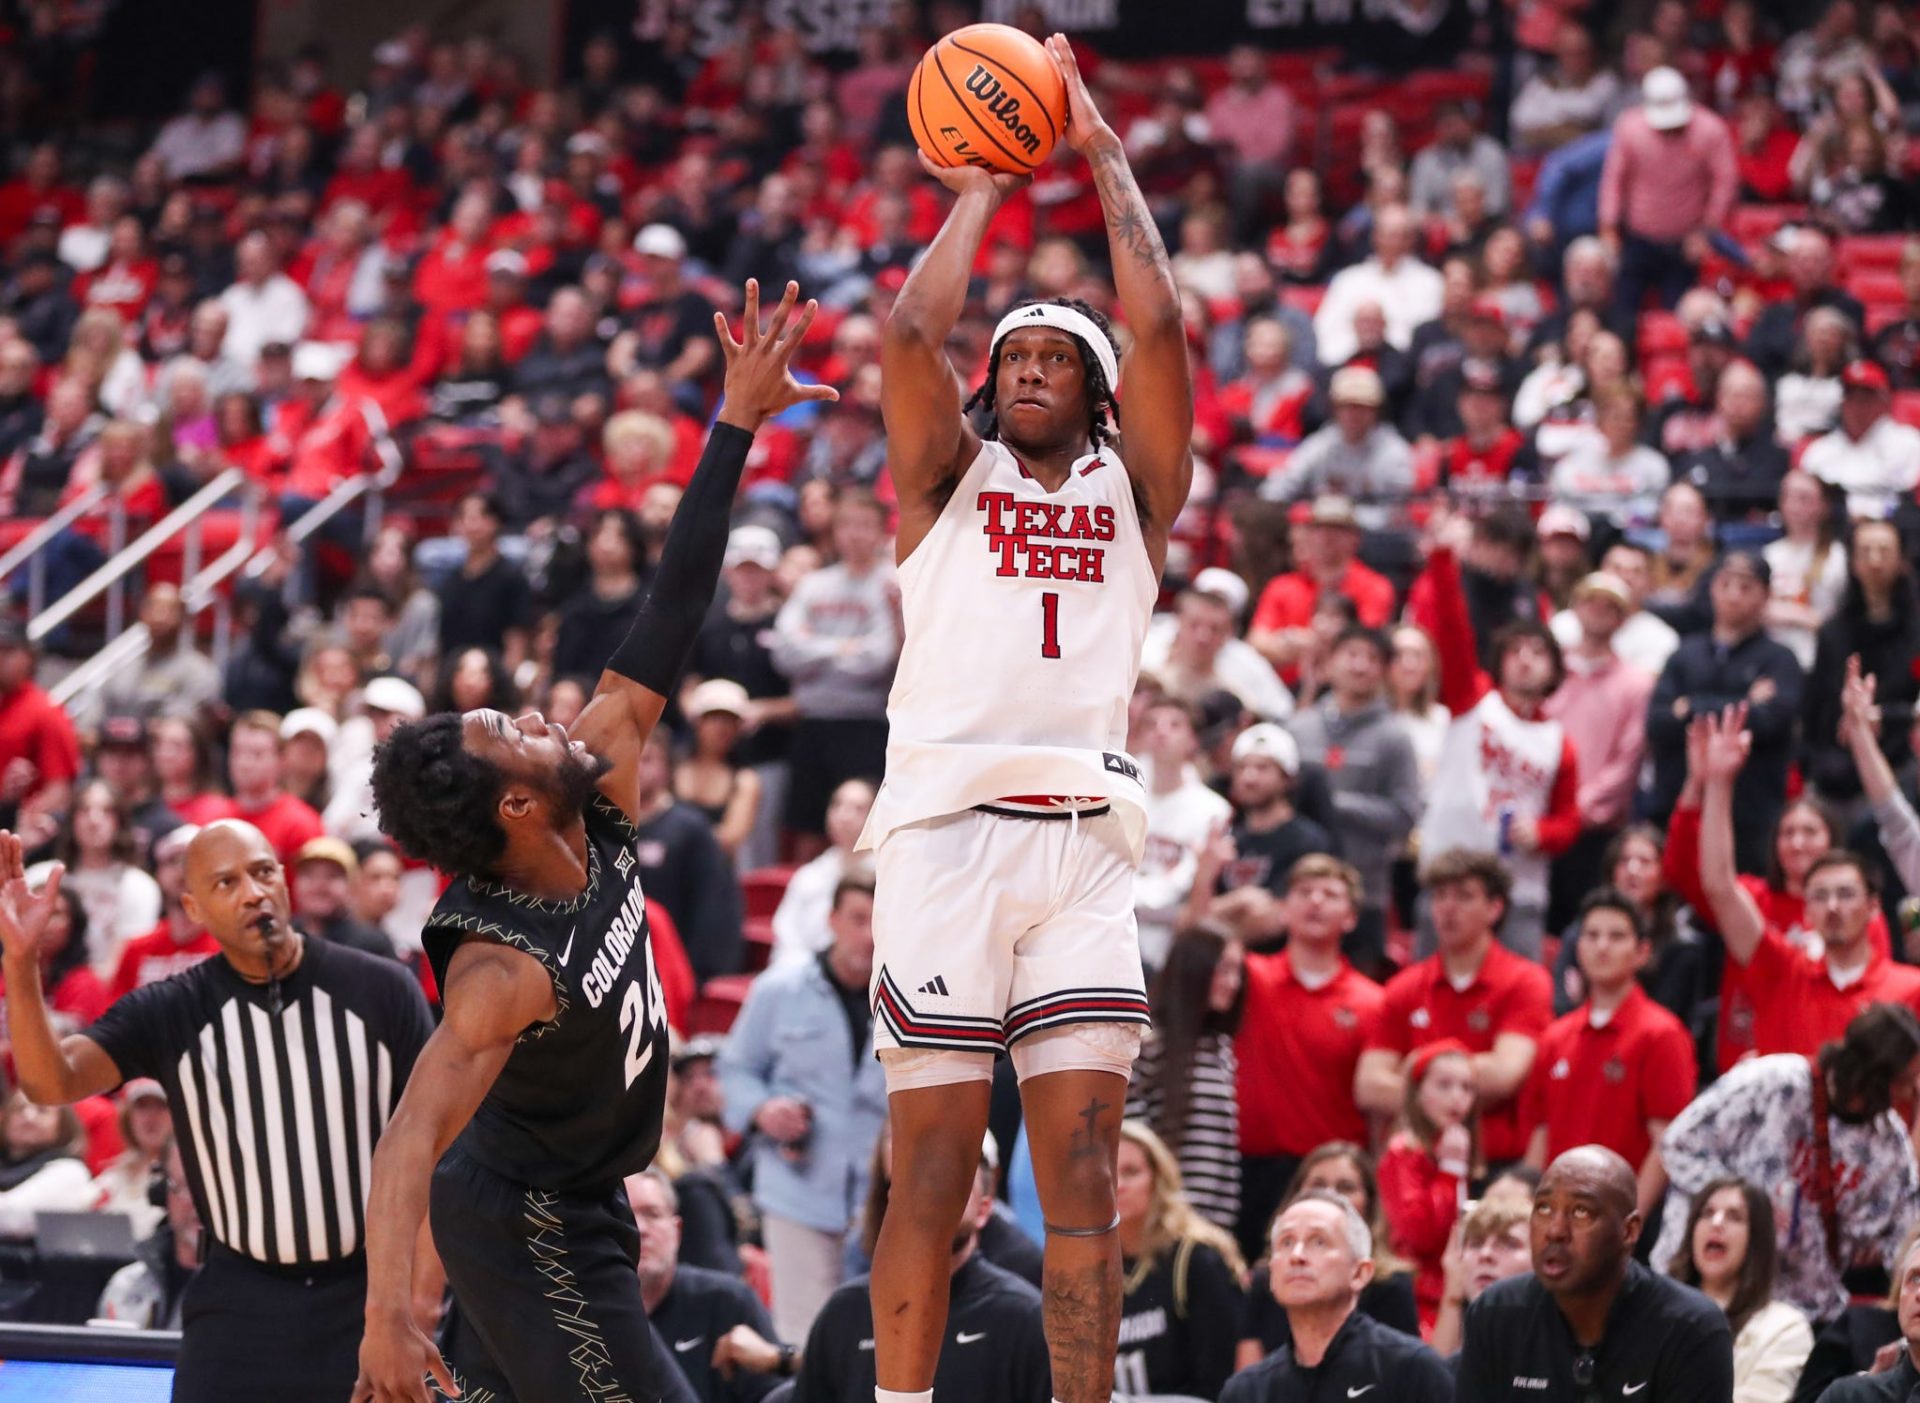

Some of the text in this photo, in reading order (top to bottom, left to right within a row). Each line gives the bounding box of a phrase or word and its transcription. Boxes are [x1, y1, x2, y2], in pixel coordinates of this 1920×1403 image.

[965, 63, 1041, 155] Wilson
[977, 492, 1115, 542] TEXAS
[989, 533, 1105, 583] TECH
[1041, 592, 1061, 659] 1
[582, 875, 645, 1008] COLORADO
[619, 931, 668, 1091] 24
